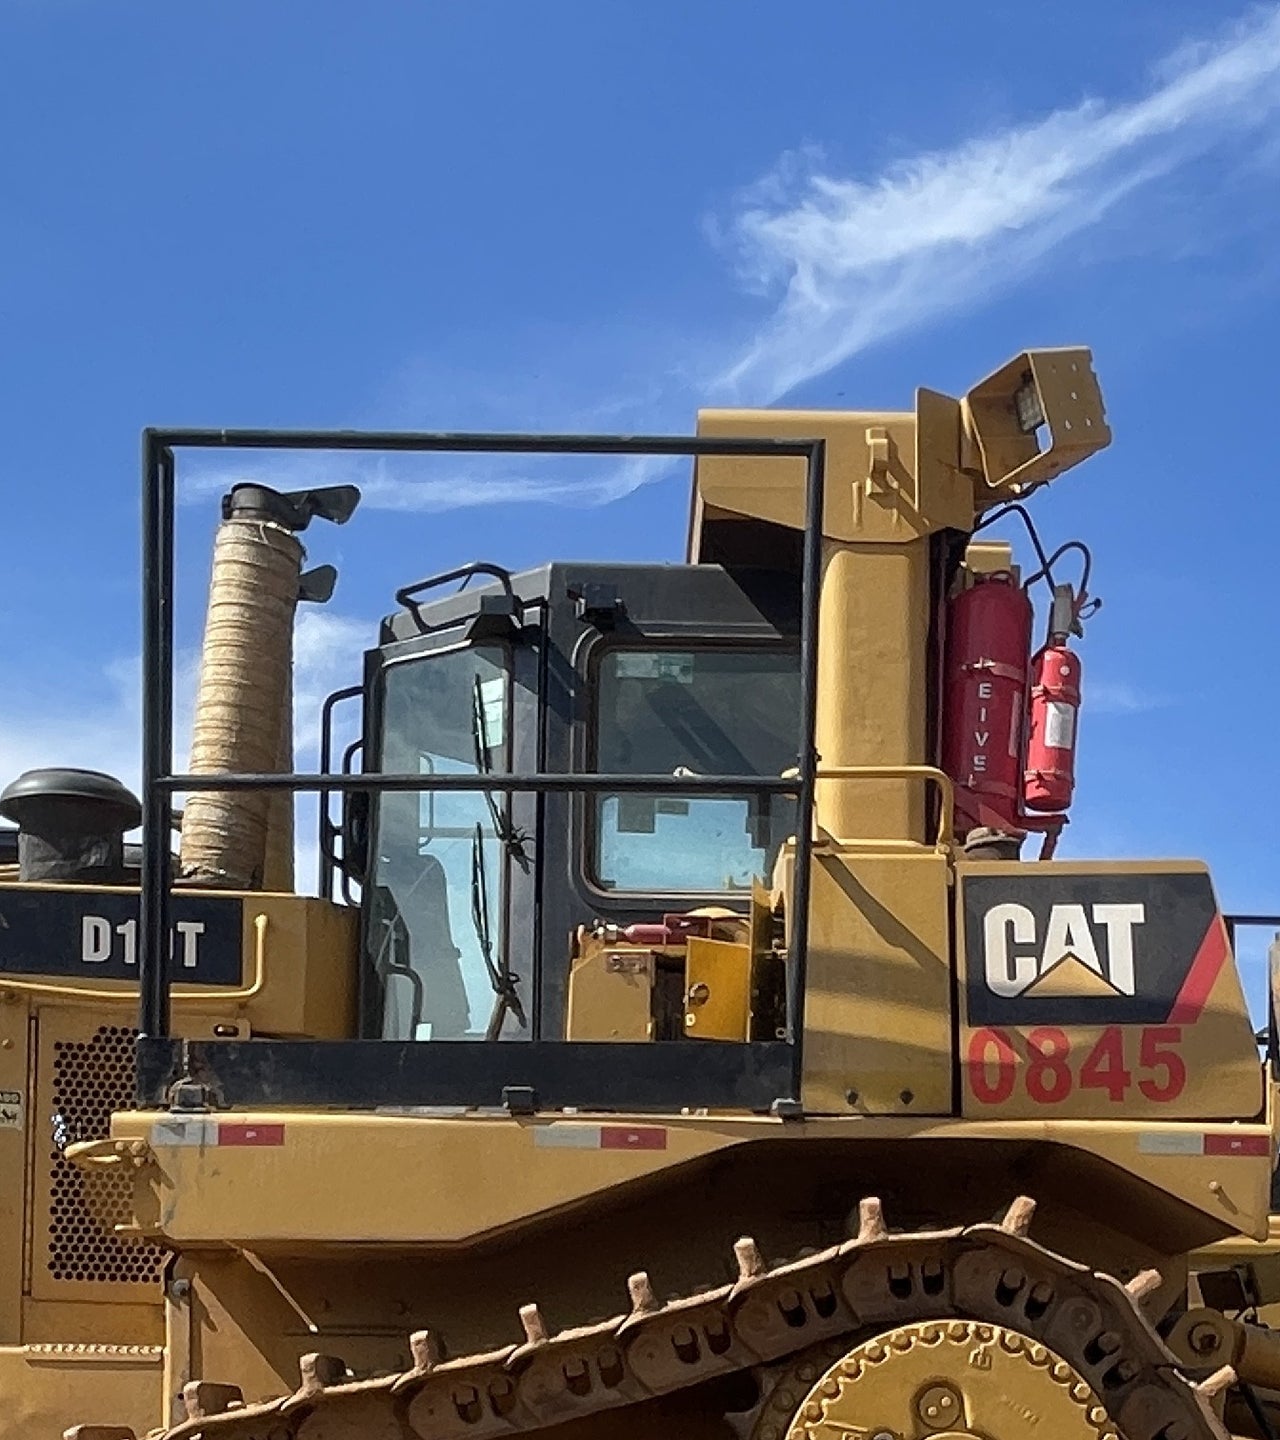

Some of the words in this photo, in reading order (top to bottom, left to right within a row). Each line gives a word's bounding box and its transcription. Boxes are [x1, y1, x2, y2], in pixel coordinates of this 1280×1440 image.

[82, 916, 205, 968] D1T
[984, 903, 1144, 998] CAT
[968, 1026, 1186, 1104] 0845
